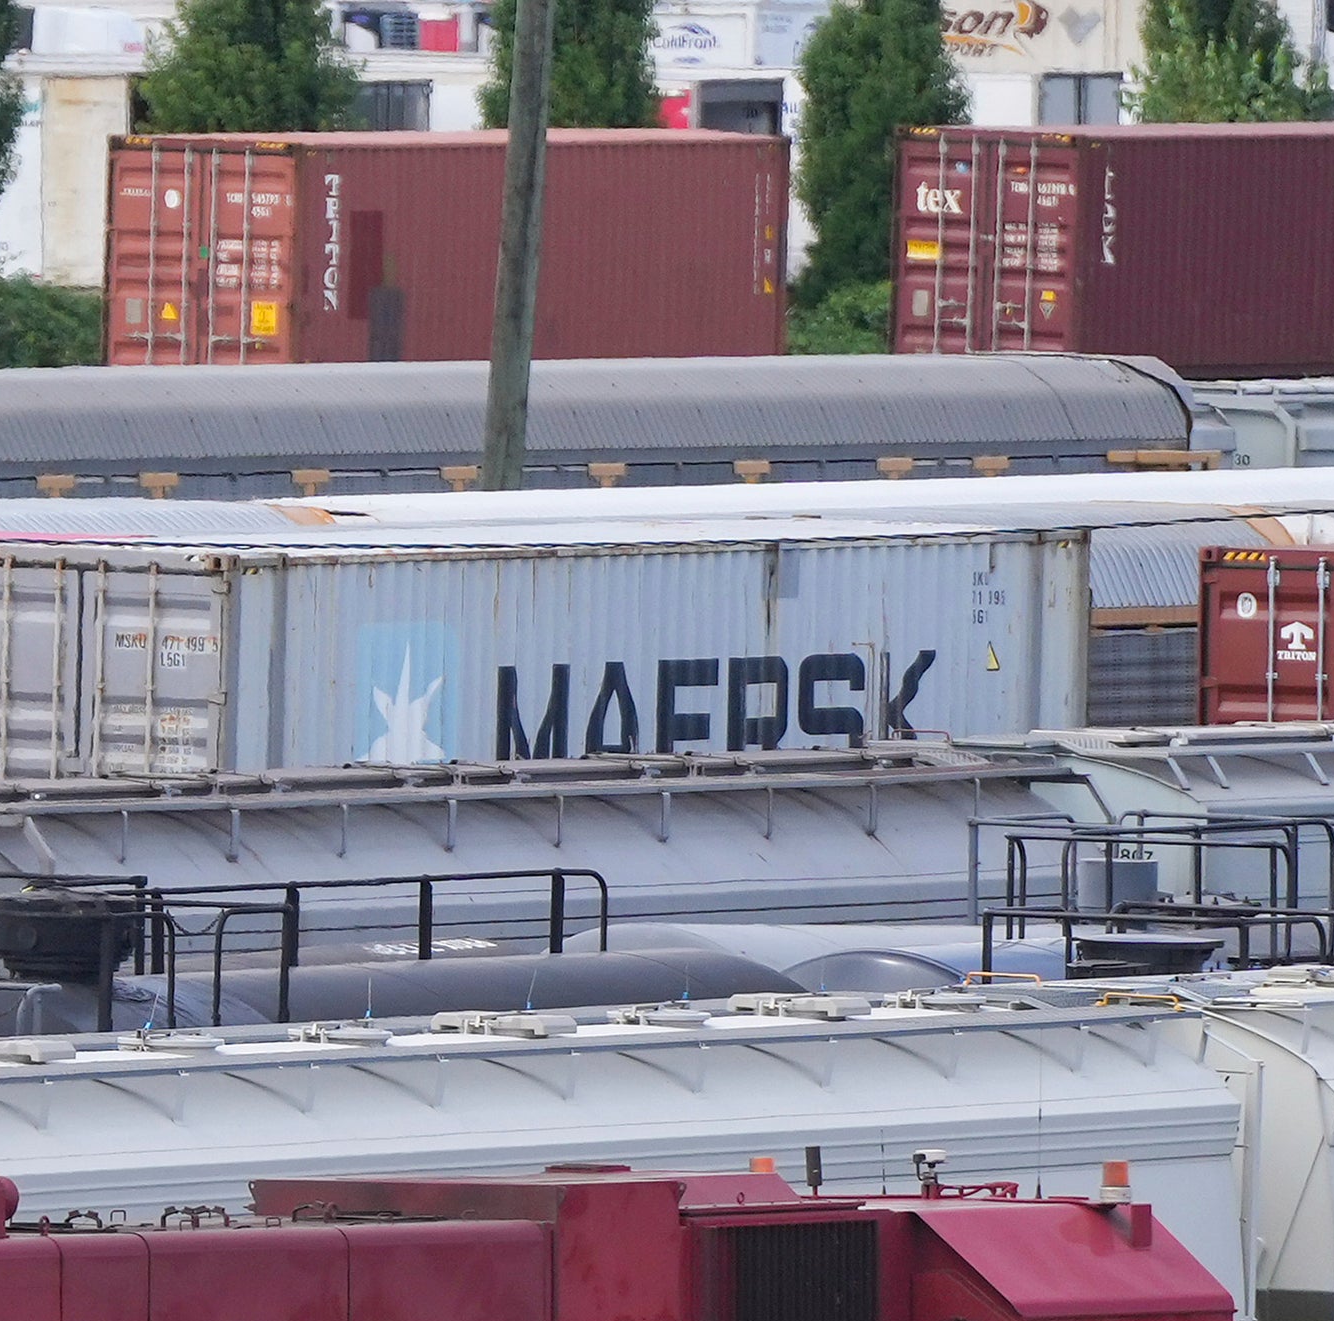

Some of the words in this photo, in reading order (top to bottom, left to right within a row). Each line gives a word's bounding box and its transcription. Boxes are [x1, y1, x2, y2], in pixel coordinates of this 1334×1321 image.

[916, 181, 963, 214] tex
[1234, 454, 1250, 466] 30
[1276, 650, 1317, 662] TRITON
